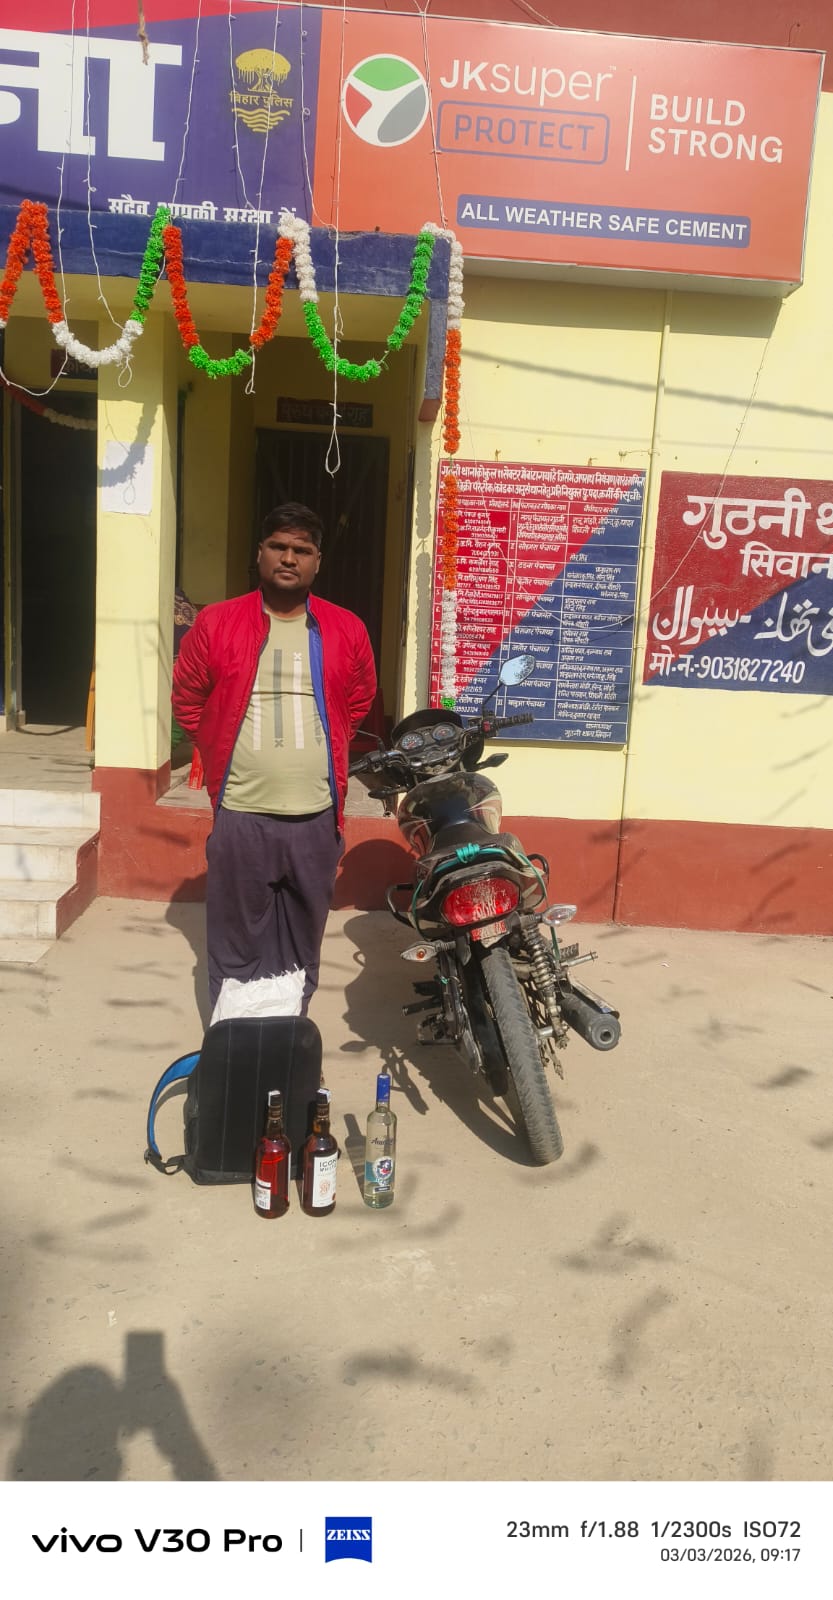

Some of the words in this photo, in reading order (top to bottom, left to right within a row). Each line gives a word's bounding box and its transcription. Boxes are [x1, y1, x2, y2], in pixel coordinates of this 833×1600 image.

[229, 90, 260, 106] बिहार
[261, 93, 294, 109] पुलिस
[649, 93, 746, 126] BUILD
[454, 113, 596, 152] PROTECT
[648, 127, 783, 164] STRONG
[461, 202, 499, 222] ALL
[505, 206, 602, 229] WEATHER
[607, 213, 659, 234] SAFE
[665, 217, 747, 241] CEMENT
[682, 487, 812, 550] गुठनी
[739, 541, 833, 579] सिवान
